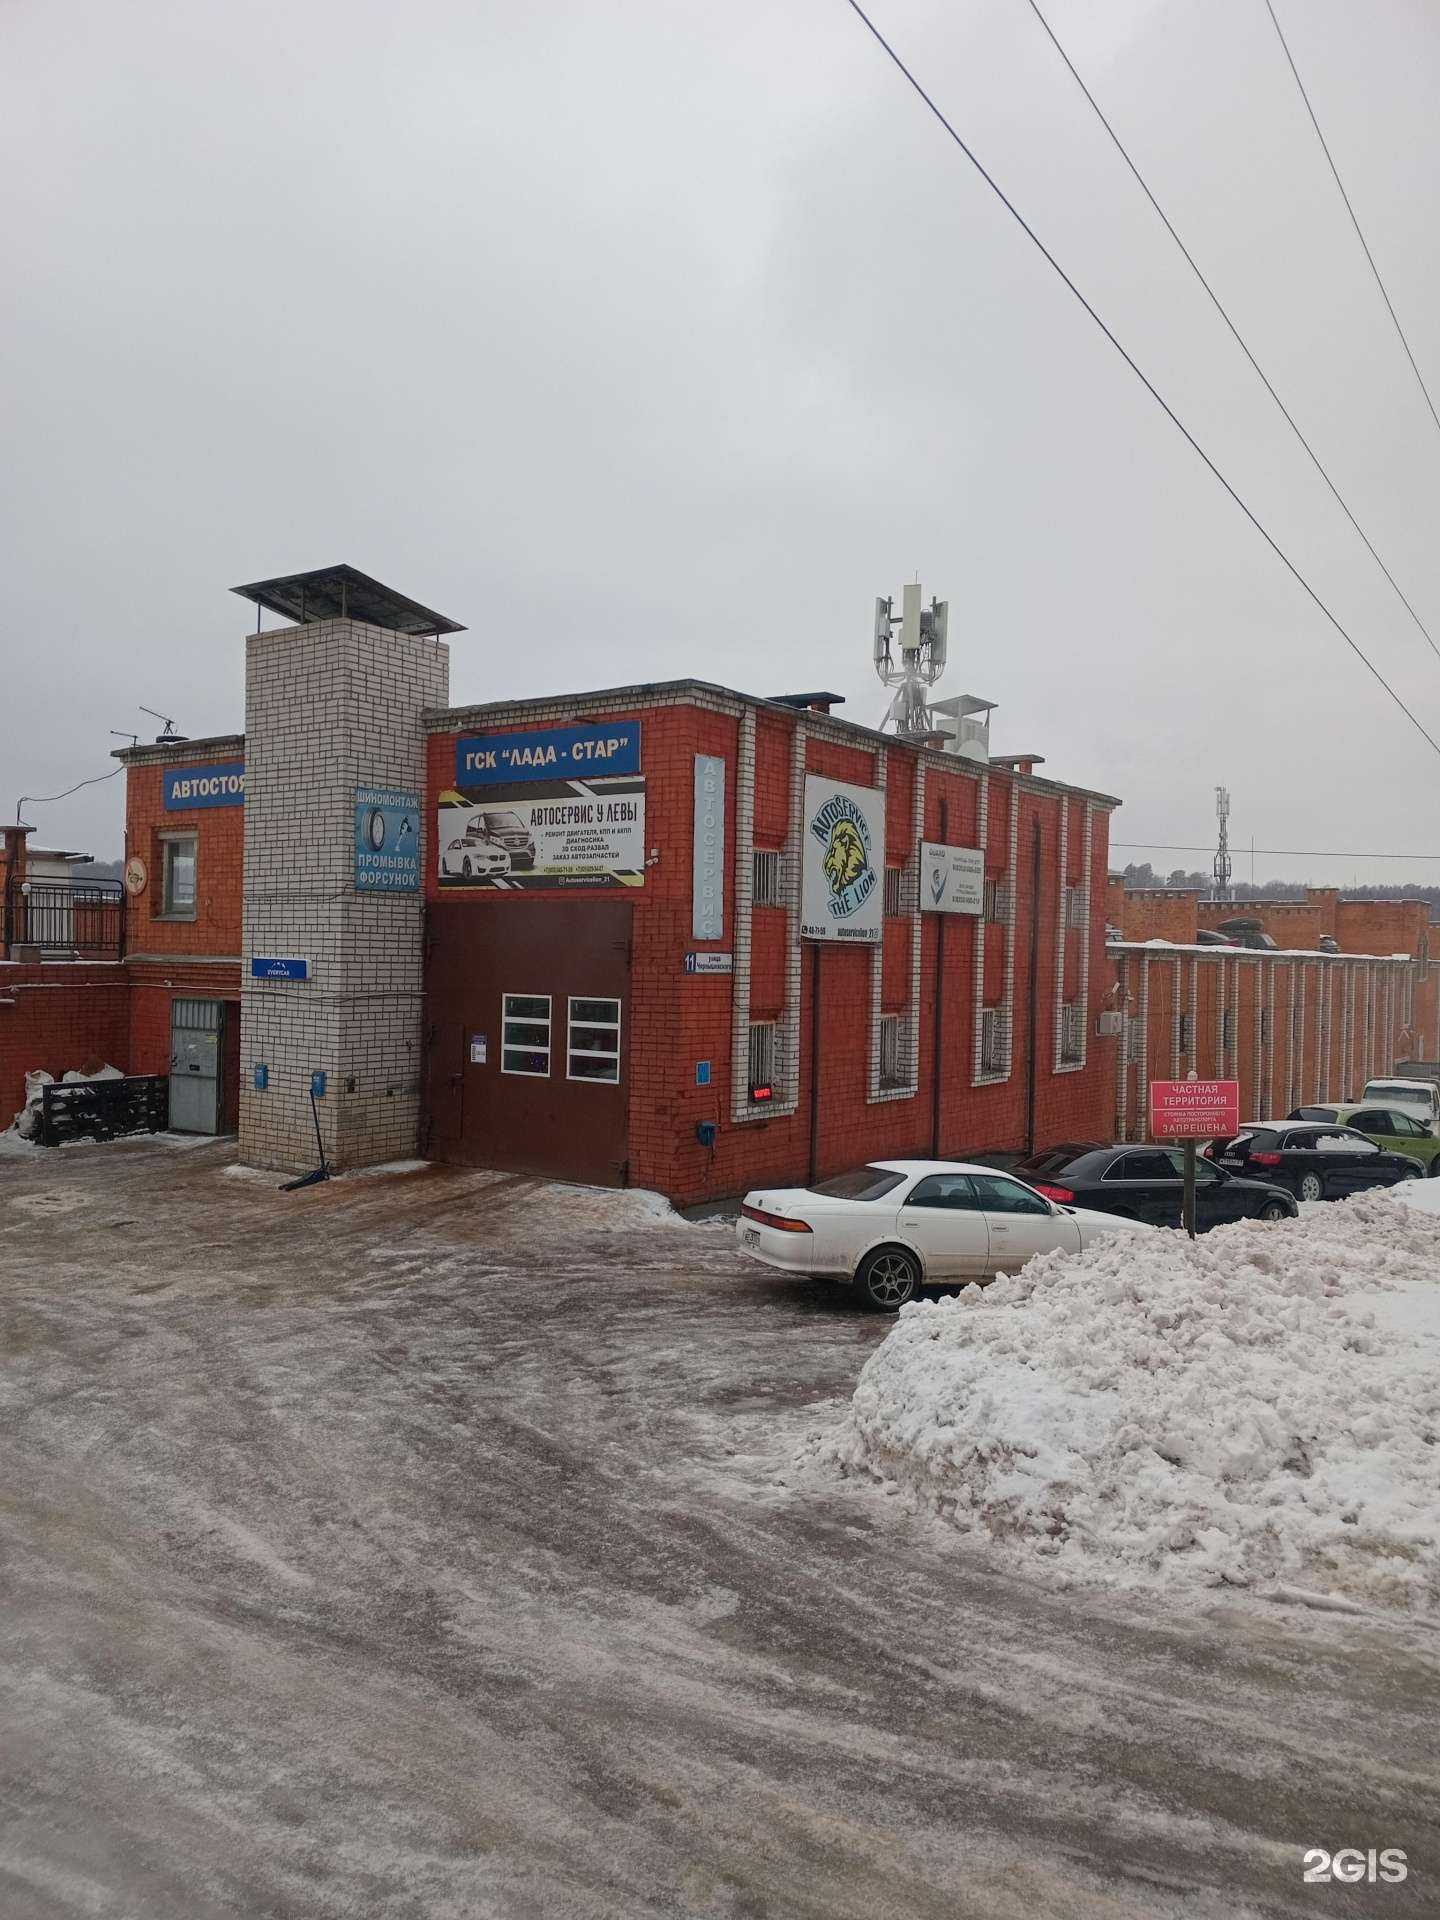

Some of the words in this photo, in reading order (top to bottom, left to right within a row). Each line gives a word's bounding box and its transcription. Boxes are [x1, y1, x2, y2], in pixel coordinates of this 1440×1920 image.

[466, 751, 496, 770] ГСК
[357, 790, 419, 809] ШИНОМОНТАЖ
[530, 804, 593, 827] АВТОСЕРВИС
[597, 803, 604, 822] У
[607, 801, 637, 822] ЛЕВЫ
[703, 761, 717, 934] АВТОСЕРВИС
[358, 854, 417, 870] ПРОМЫВКА
[571, 852, 619, 860] АВТОЗАПЧАСТЕЙ
[360, 871, 416, 886] ФОРСУНОК
[831, 891, 853, 916] THE
[854, 870, 876, 904] LION
[685, 954, 695, 971] 11
[1172, 1085, 1218, 1094] ЧАСТНАЯ
[1163, 1096, 1227, 1106] ТЕРРИТОРИЯ
[1162, 1123, 1228, 1133] ЗАПРЕЩЕНА
